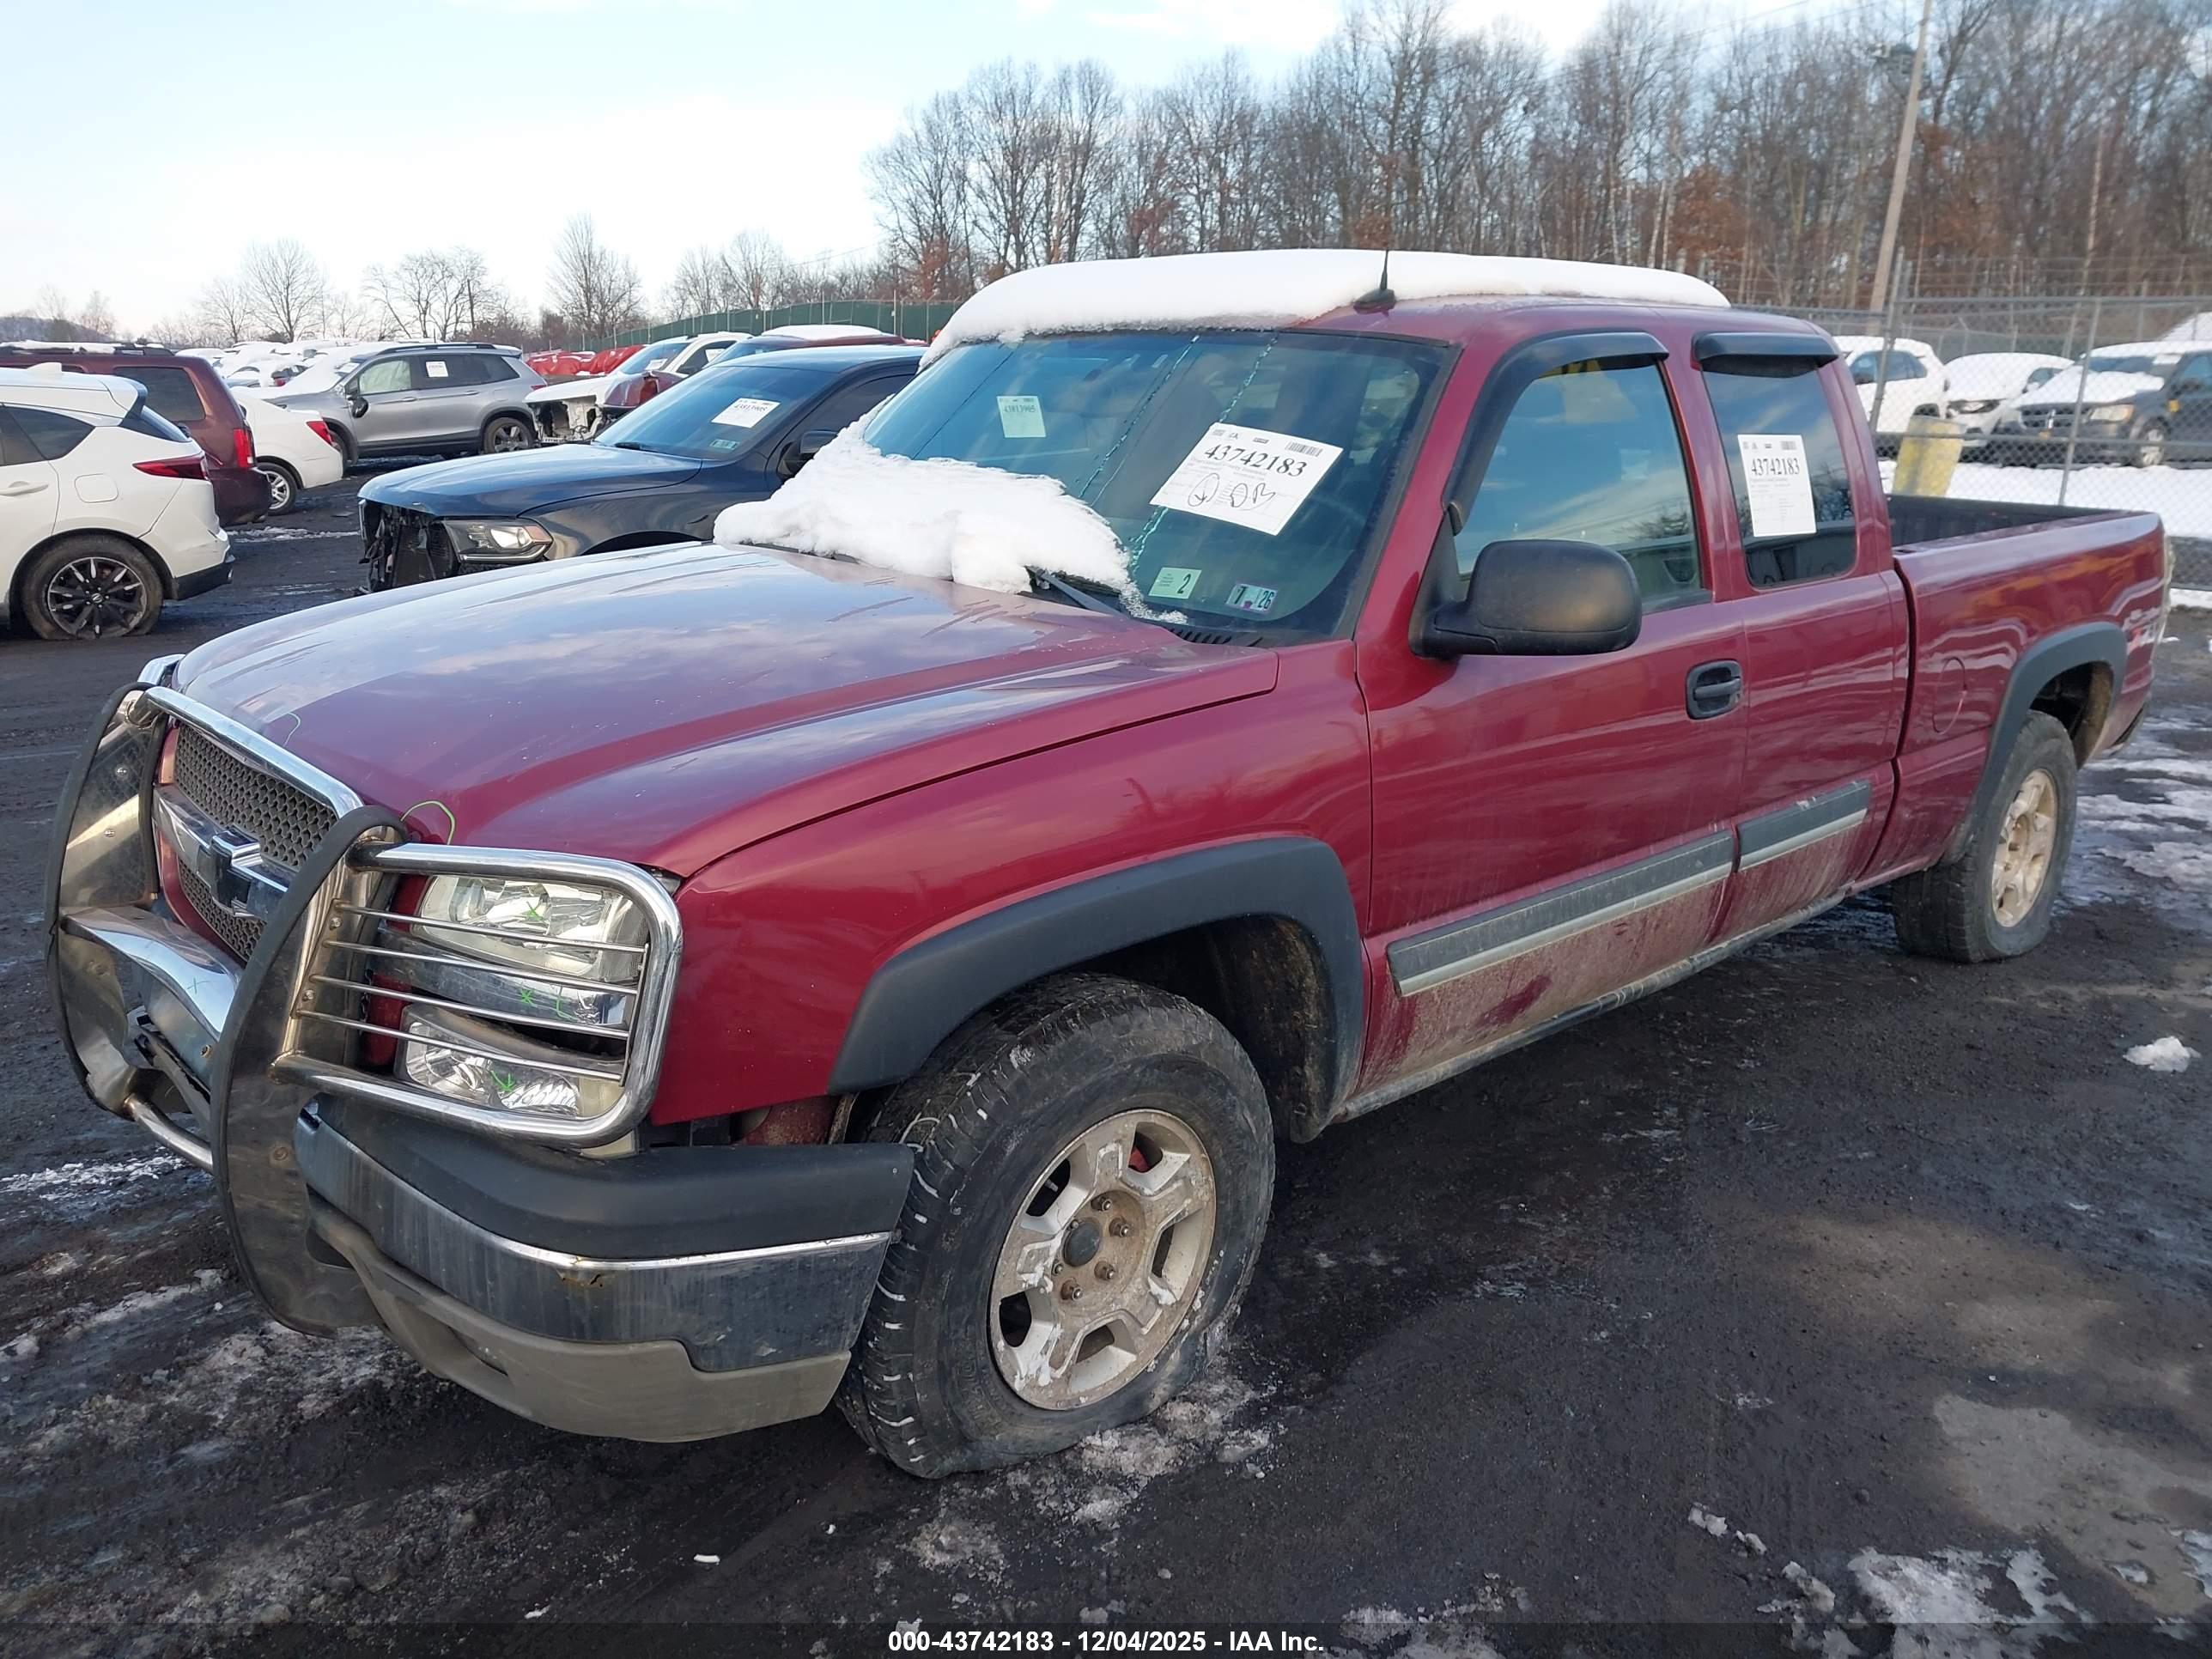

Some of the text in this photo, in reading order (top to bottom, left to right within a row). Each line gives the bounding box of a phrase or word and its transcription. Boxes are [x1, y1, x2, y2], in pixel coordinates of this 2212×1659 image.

[1205, 444, 1307, 477] 43742183
[1752, 458, 1800, 475] 43742183
[1176, 573, 1192, 594] 2
[1257, 590, 1274, 609] 26
